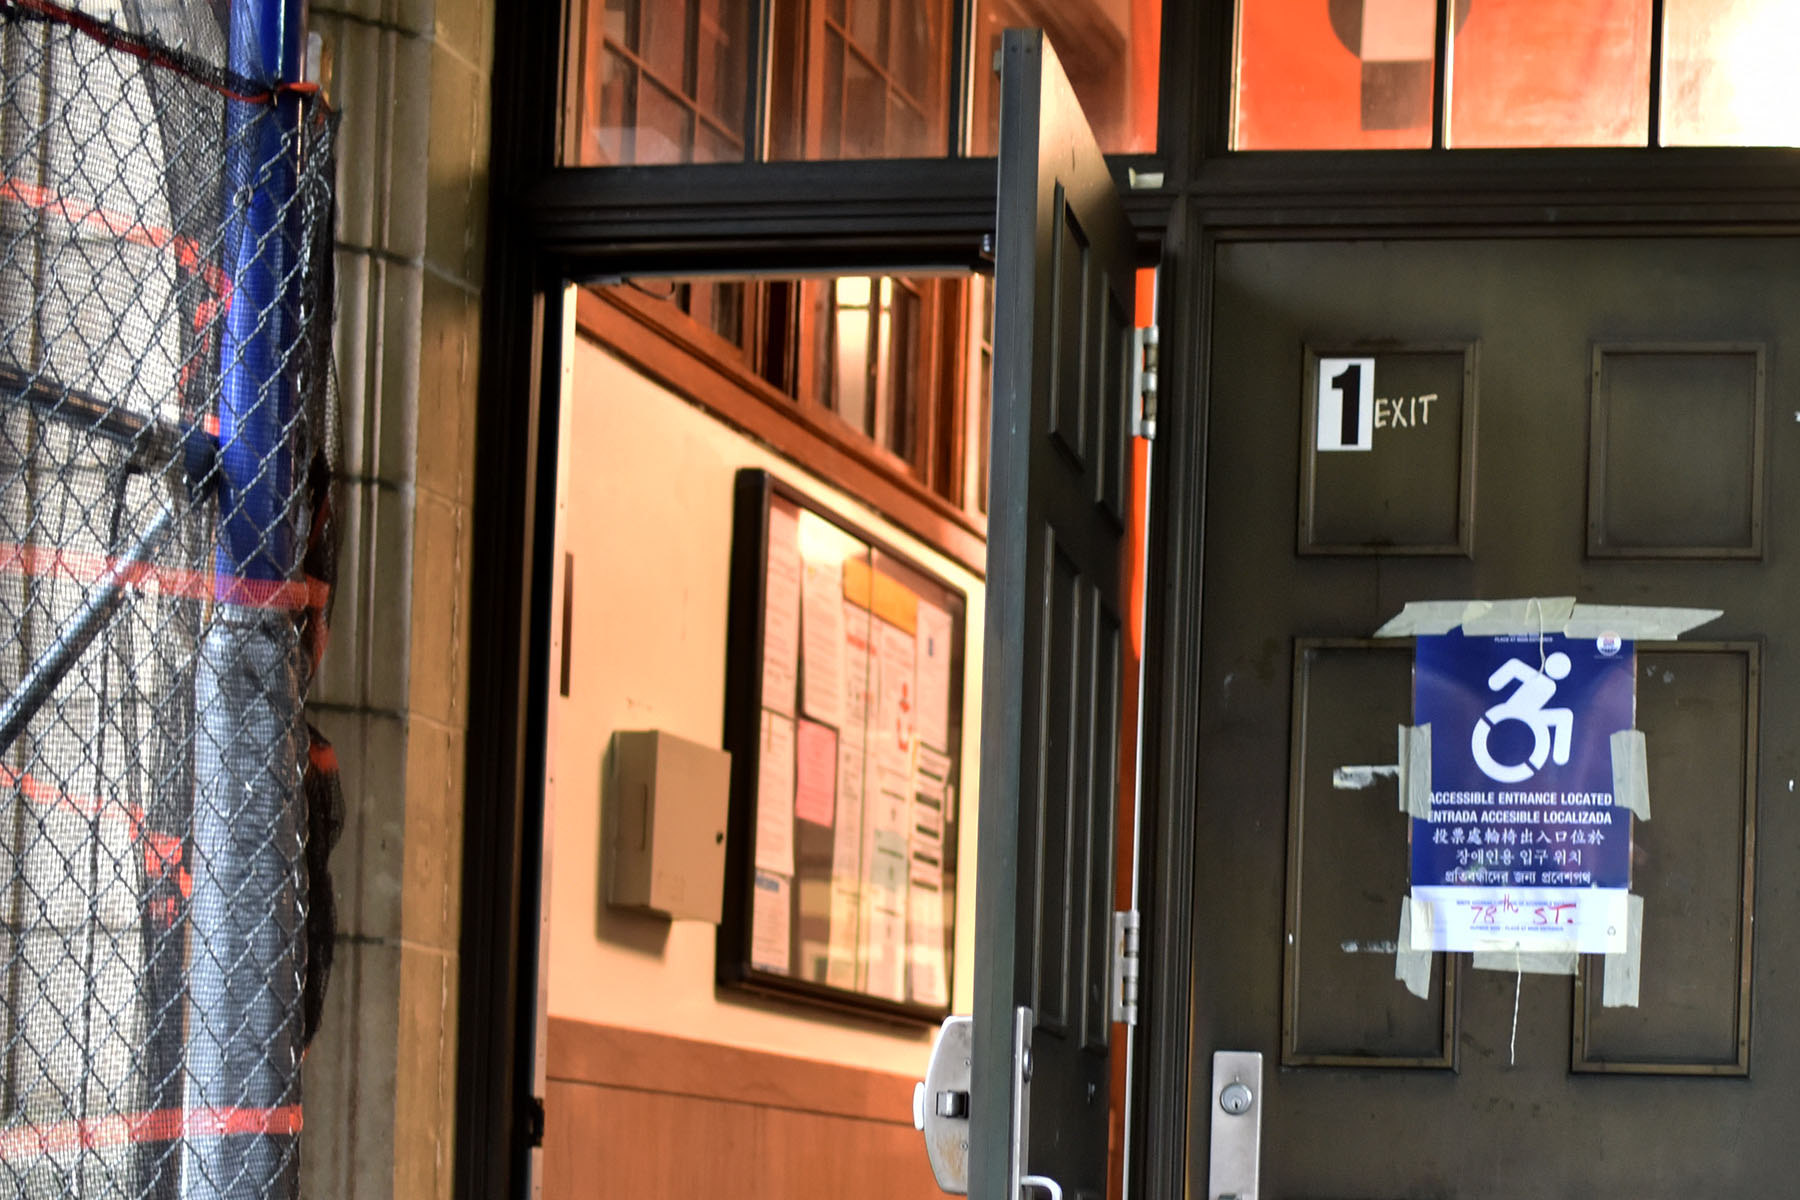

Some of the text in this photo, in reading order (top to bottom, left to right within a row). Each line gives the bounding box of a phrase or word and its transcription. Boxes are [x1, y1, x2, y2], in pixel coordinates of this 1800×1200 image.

[1332, 364, 1361, 446] 1
[1374, 393, 1438, 429] EXIT
[1429, 791, 1612, 806] ACCESSIBLE ENTRANCE LOCATED
[1428, 810, 1612, 824] ENTRADA ACCESIBLE LOCALIZADA
[1456, 848, 1582, 866] 장애인용 입구 위치
